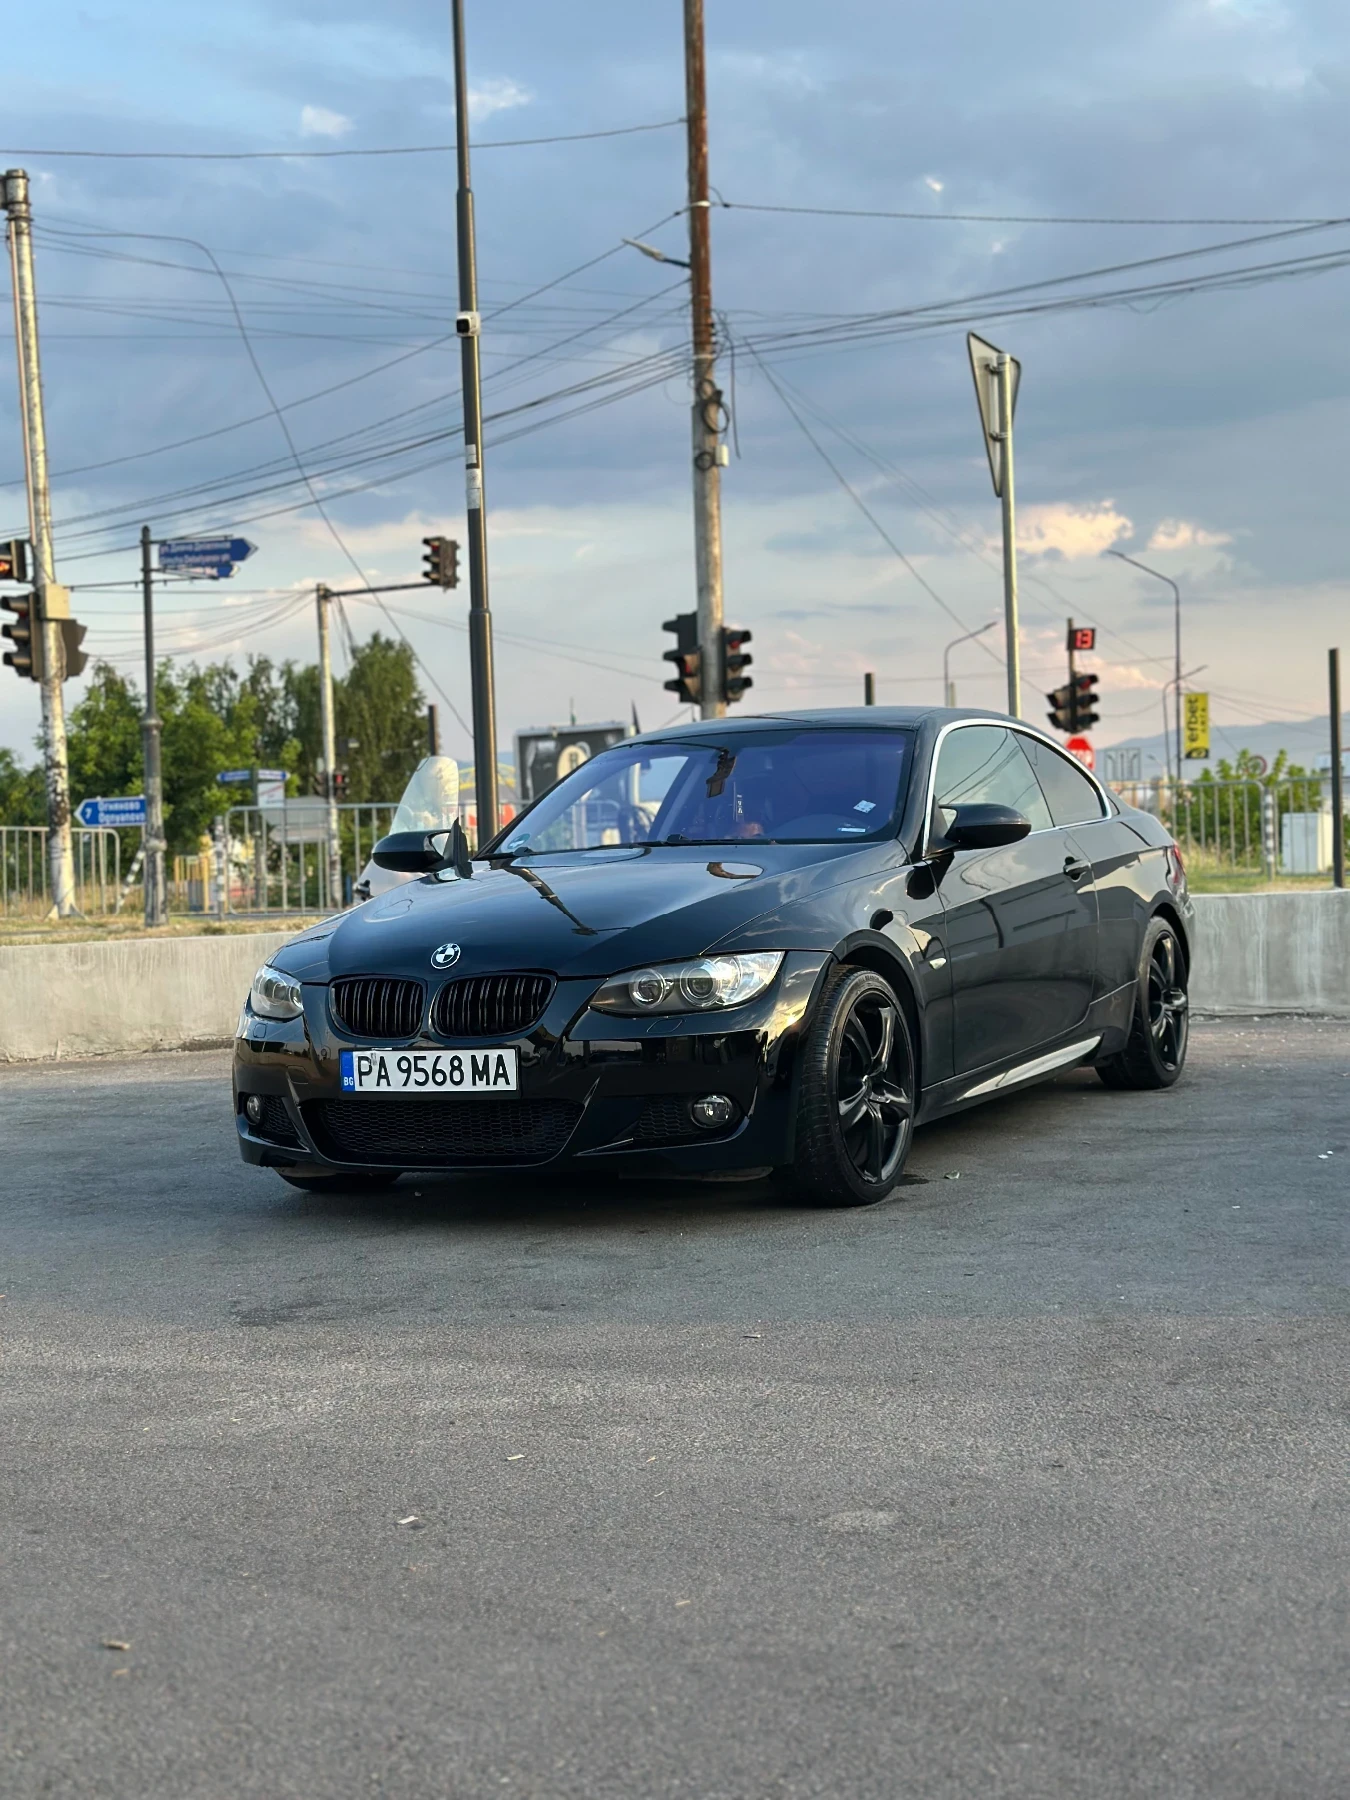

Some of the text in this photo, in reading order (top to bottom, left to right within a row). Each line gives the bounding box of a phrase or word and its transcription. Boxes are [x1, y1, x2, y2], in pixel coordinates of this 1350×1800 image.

[1075, 630, 1093, 648] 13
[357, 1054, 511, 1086] PA 9568 MA
[343, 1076, 354, 1086] BG
